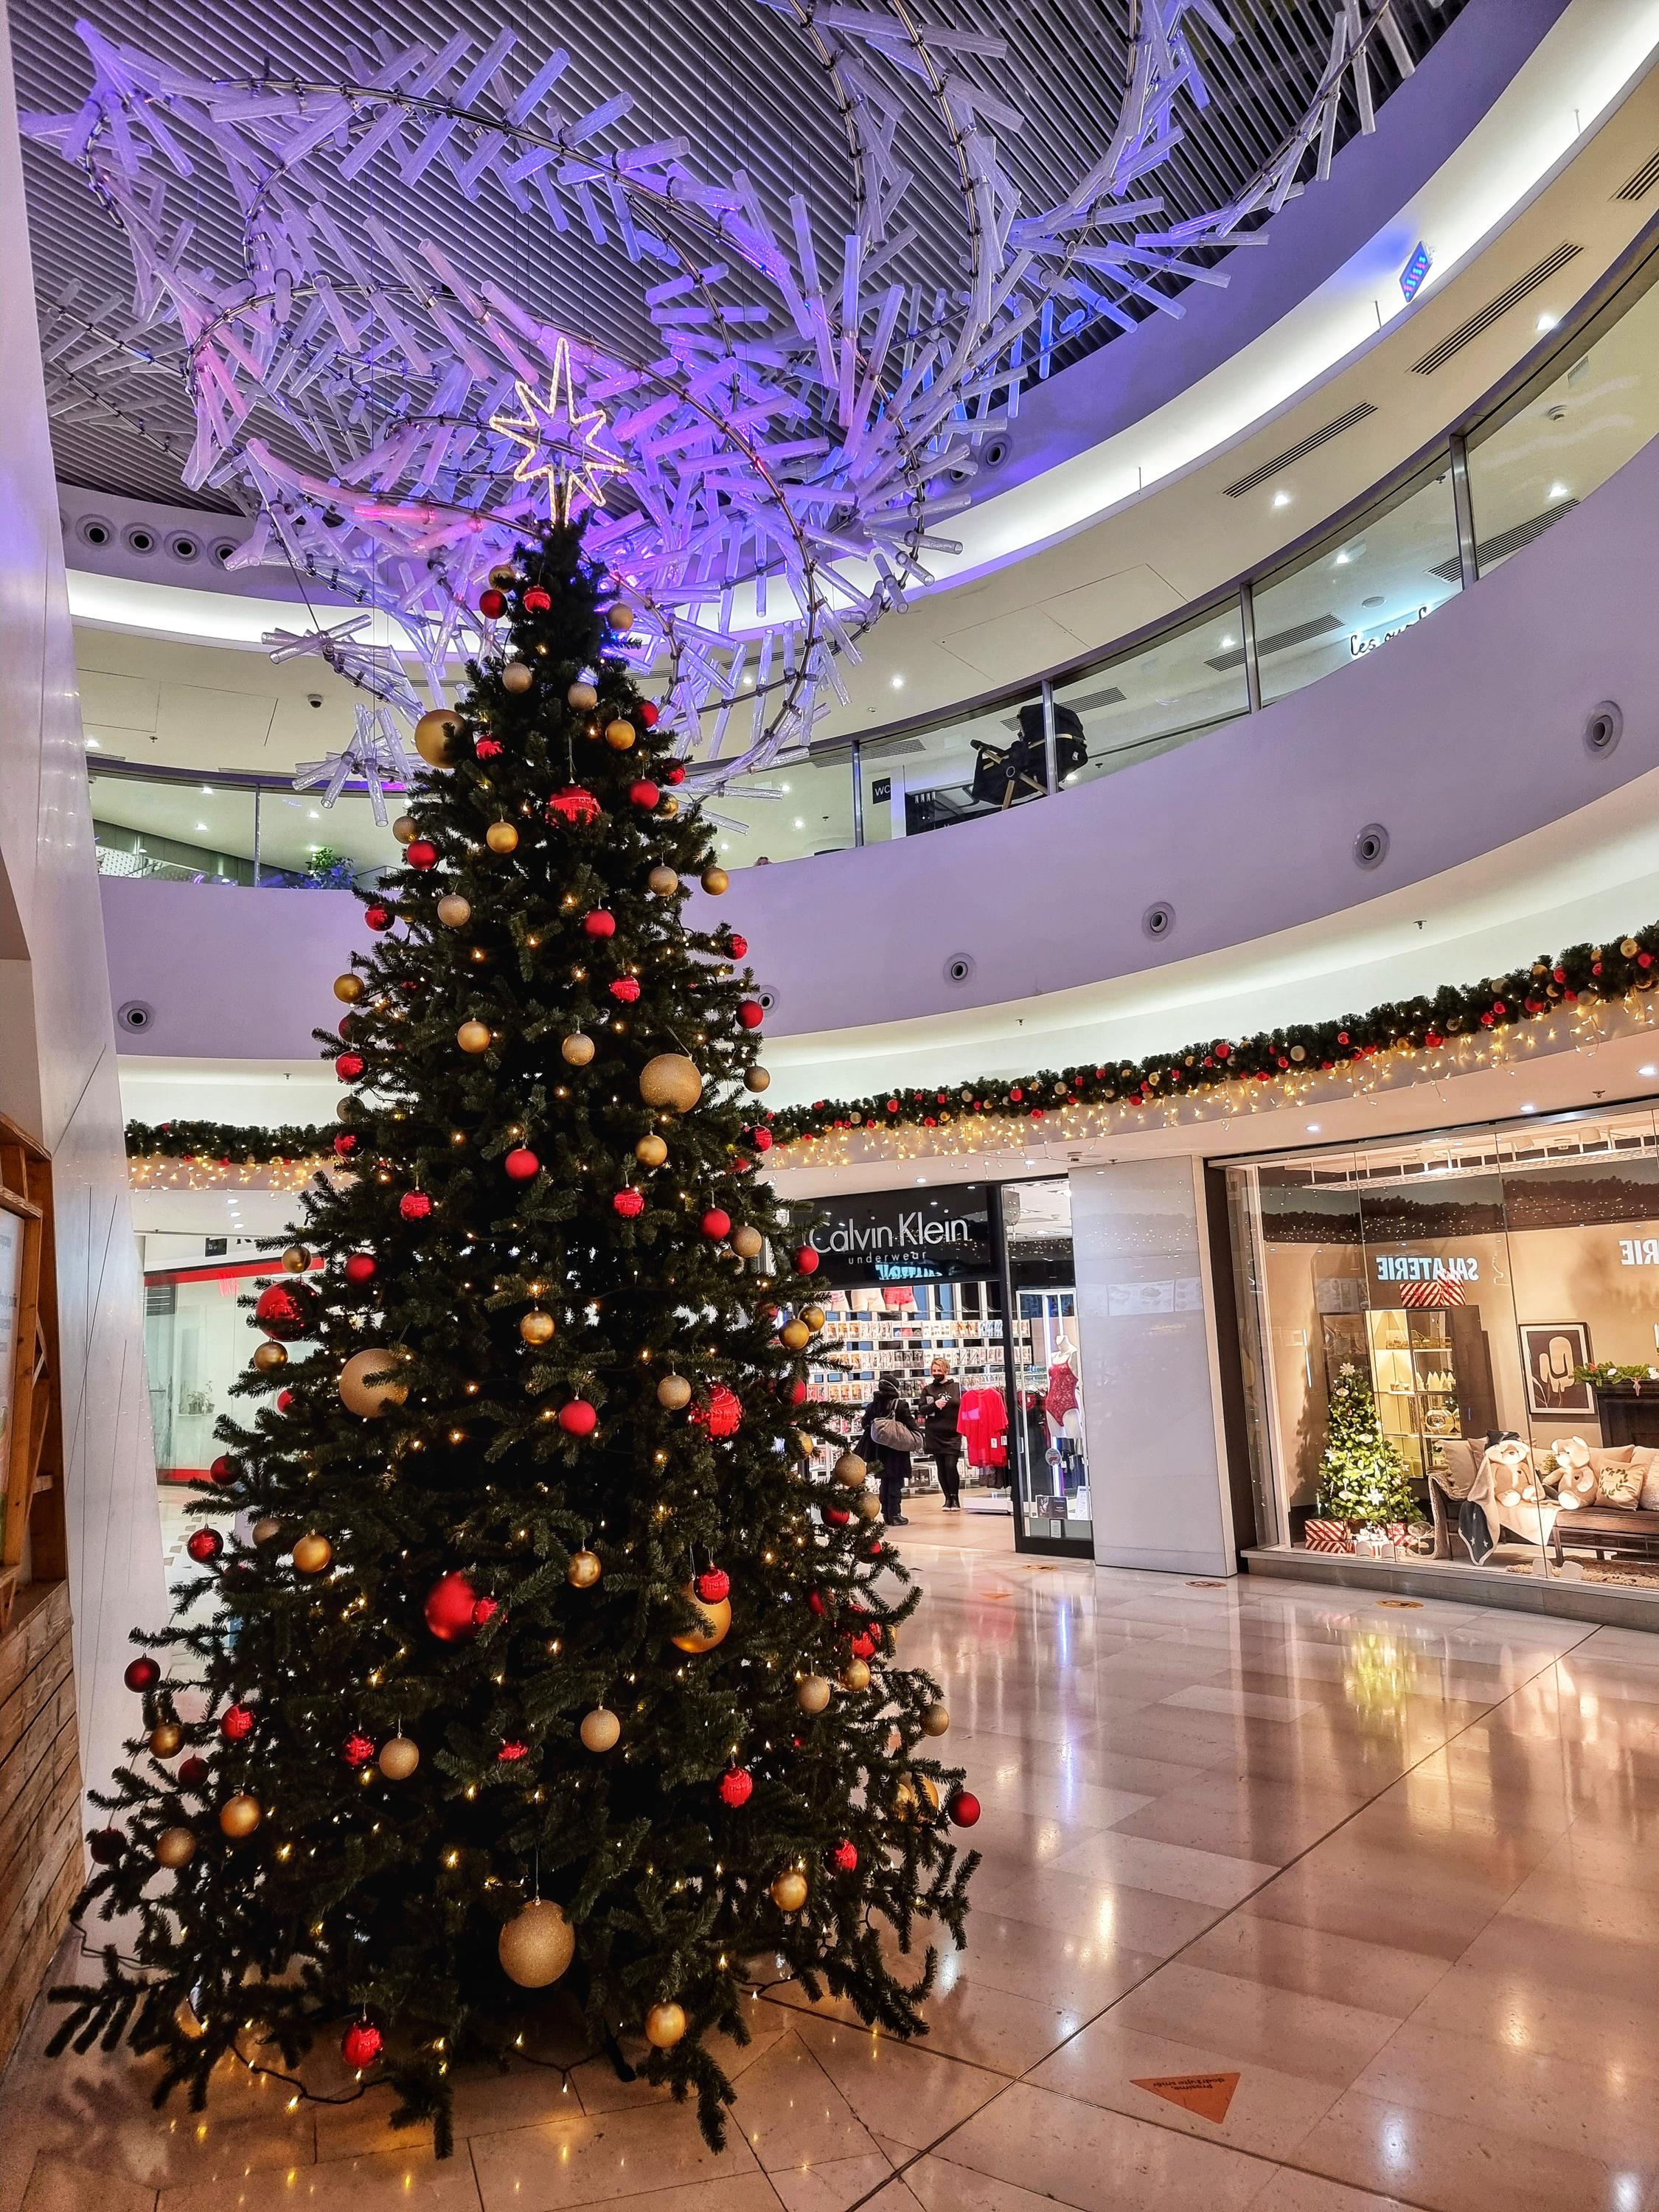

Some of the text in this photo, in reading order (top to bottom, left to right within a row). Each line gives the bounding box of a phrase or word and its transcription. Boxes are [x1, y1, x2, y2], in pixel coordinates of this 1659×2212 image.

[874, 785, 891, 796] WC
[809, 1211, 968, 1253] Calvin Klein
[848, 1251, 927, 1265] underwear
